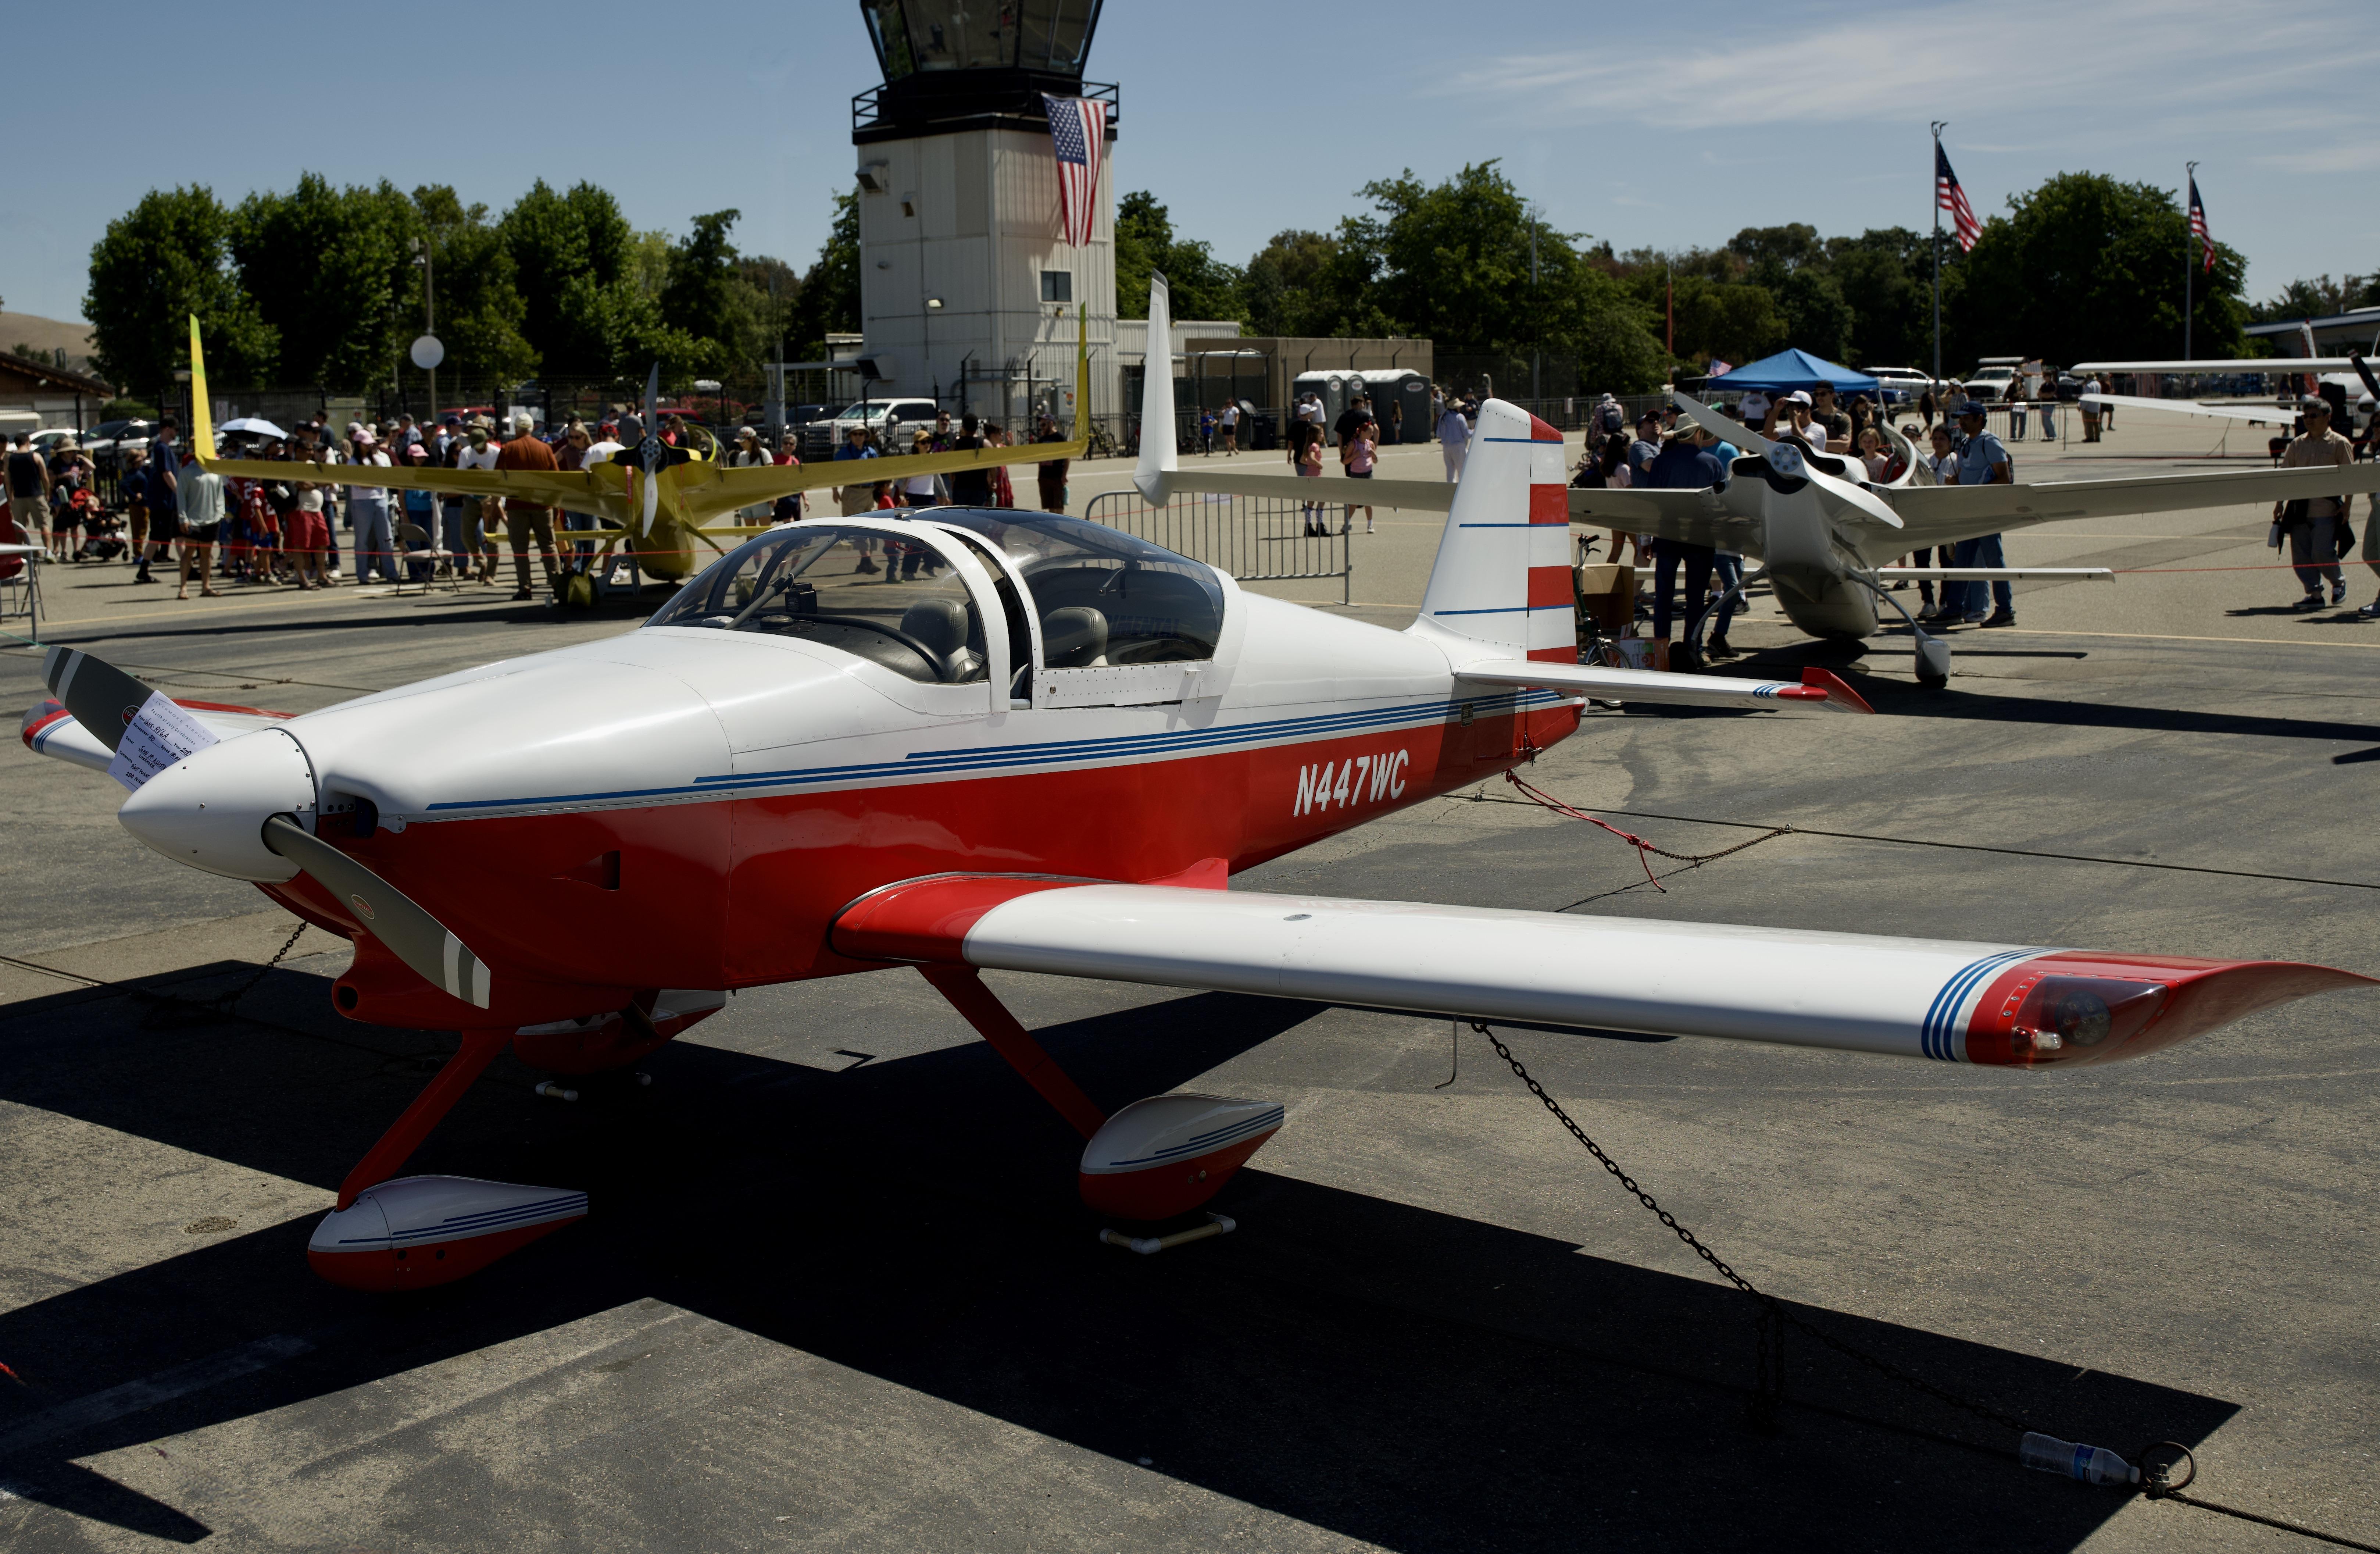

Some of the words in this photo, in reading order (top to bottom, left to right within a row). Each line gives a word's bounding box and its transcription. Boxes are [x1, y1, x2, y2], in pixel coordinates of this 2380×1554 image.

[125, 709, 134, 719] TZELL
[151, 708, 163, 719] Fourth
[166, 721, 175, 729] July
[175, 727, 196, 745] Celebration
[153, 698, 183, 723] LIVERMORE
[185, 724, 210, 744] AIRPORT
[125, 735, 135, 744] Owner
[138, 746, 149, 756] JOHN
[153, 758, 167, 770] ALLISTE
[133, 722, 149, 737] Horsepower
[161, 744, 170, 754] Speed
[154, 726, 170, 739] RV6A
[180, 747, 192, 757] 2000
[119, 750, 133, 763] Comments
[139, 754, 155, 769] LIVERMORE
[1293, 749, 1409, 817] N447WC
[353, 899, 373, 915] HARTZELL
